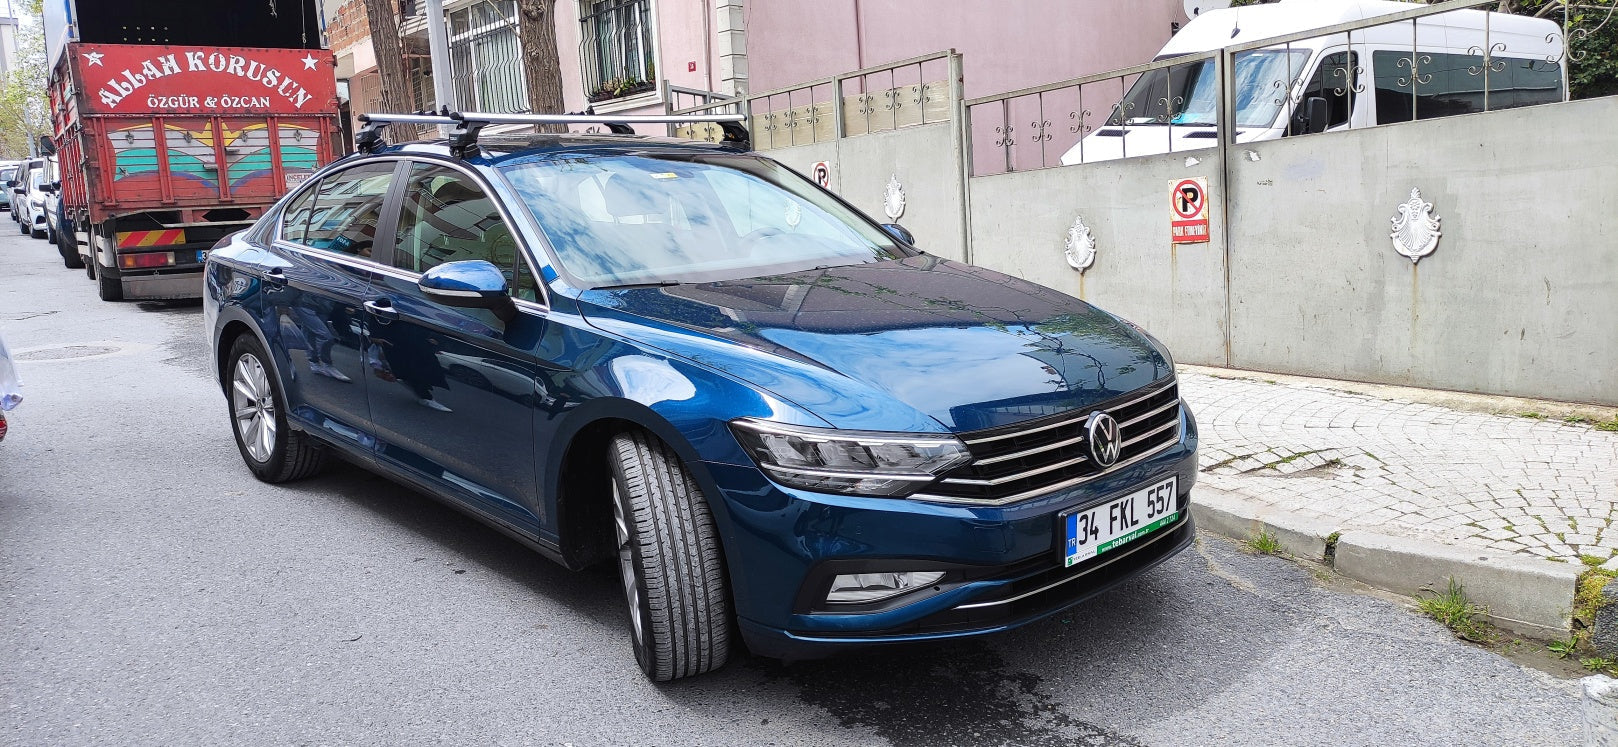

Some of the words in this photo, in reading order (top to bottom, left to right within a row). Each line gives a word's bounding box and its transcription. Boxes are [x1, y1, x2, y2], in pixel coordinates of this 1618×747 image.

[98, 52, 183, 109] ALLAH
[185, 51, 313, 109] KORUSUN
[147, 93, 200, 108] ÖZGÜR
[204, 96, 218, 108] &
[220, 93, 270, 108] ÖZCAN
[1078, 511, 1099, 546] 34
[1109, 496, 1139, 535] FKL
[1147, 480, 1174, 519] 557
[1067, 537, 1077, 548] TR
